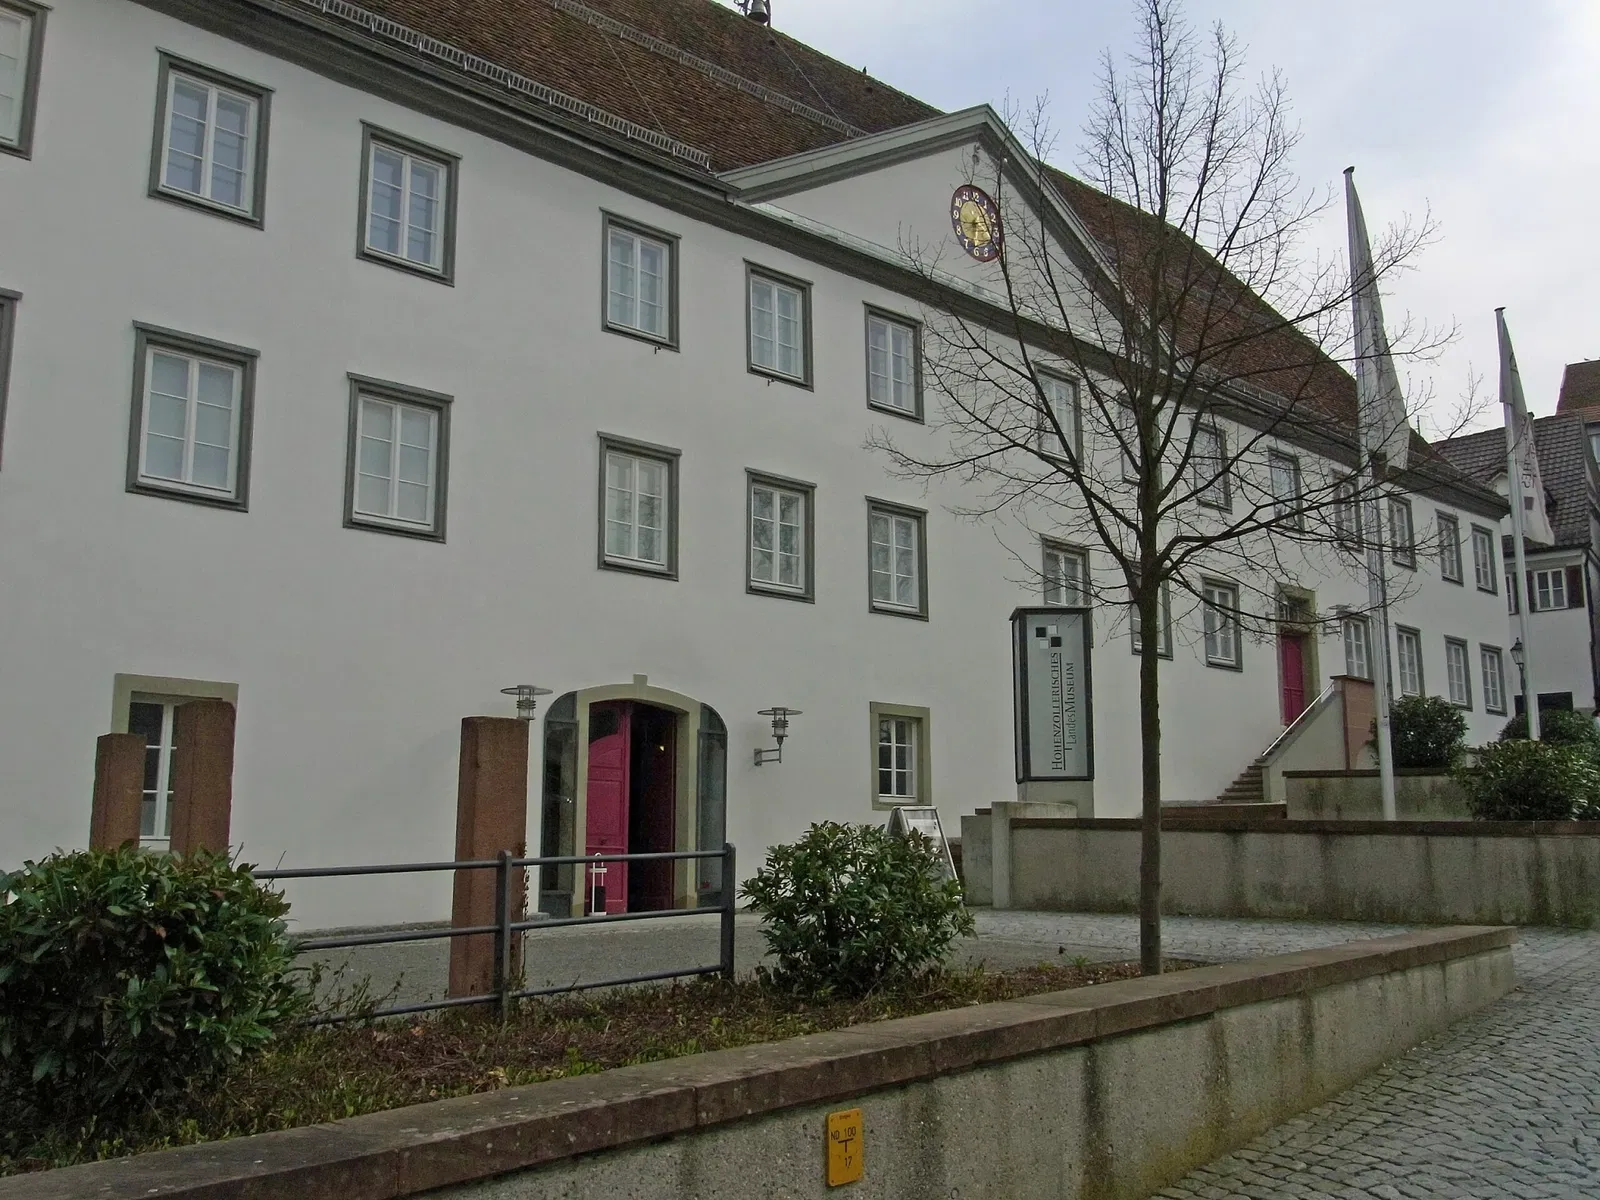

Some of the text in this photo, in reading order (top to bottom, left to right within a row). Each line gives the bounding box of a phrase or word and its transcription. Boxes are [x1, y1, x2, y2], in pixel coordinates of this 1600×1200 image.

[954, 197, 963, 208] 10
[983, 200, 988, 209] 1
[952, 210, 959, 220] 9
[990, 213, 997, 223] 2
[956, 225, 962, 236] 8
[963, 238, 969, 249] 7
[973, 247, 980, 257] 6
[1050, 652, 1063, 770] HOHENZOLLERISCHES
[843, 1126, 856, 1138] 100
